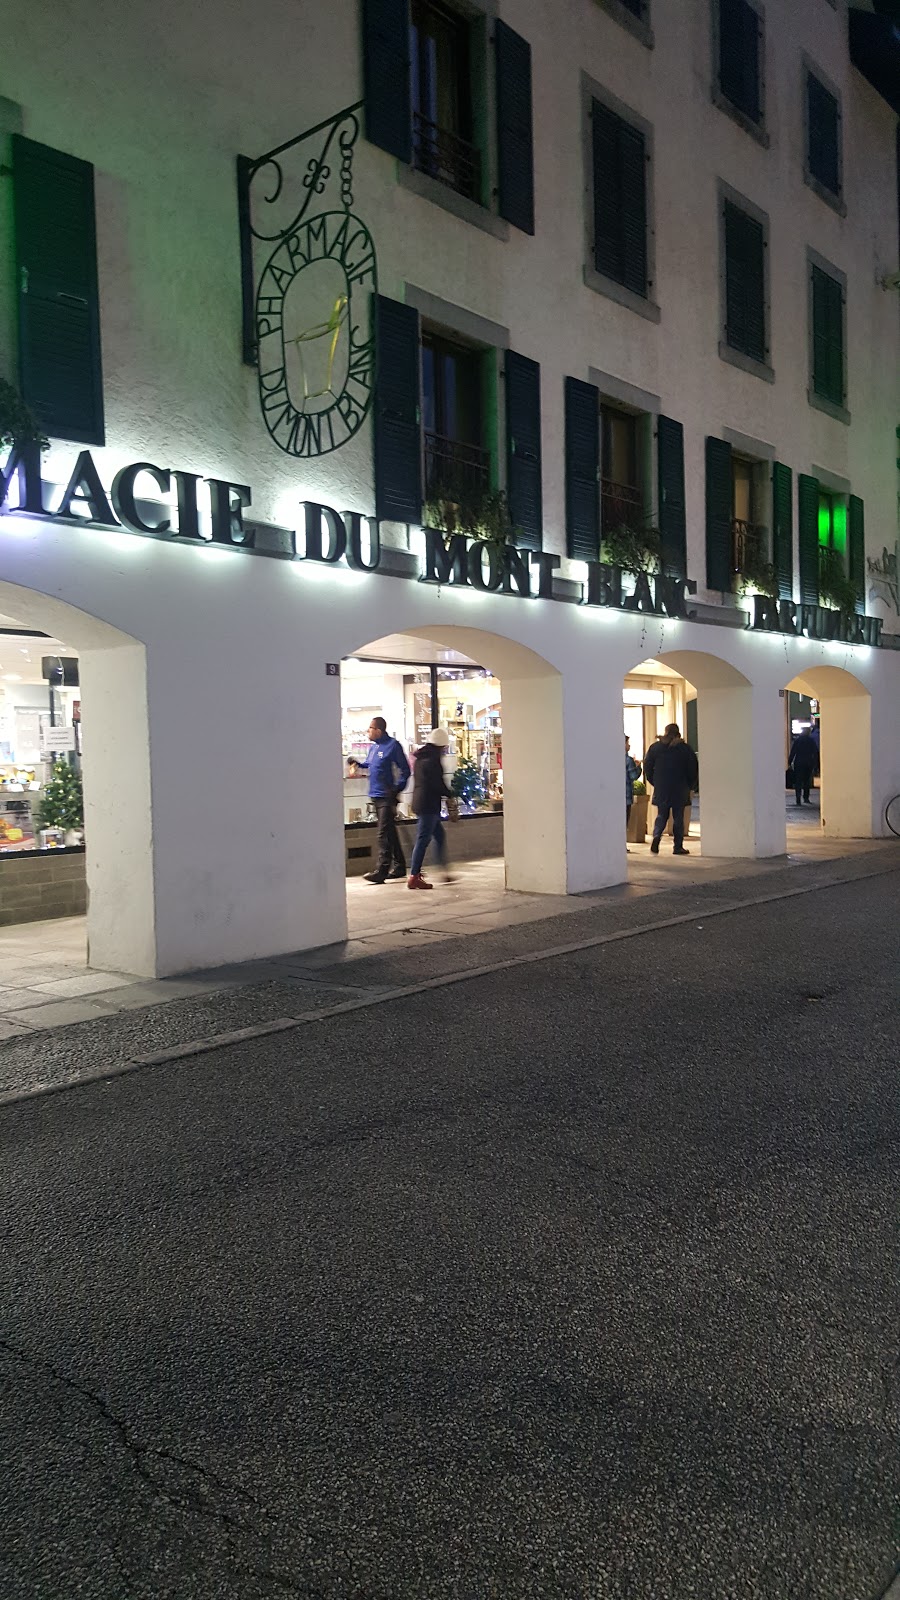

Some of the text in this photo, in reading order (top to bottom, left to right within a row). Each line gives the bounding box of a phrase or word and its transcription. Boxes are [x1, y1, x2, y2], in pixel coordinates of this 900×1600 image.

[257, 213, 376, 456] PHARMACIE DU MONT BLANC
[299, 501, 381, 571] DU
[419, 529, 561, 599] MONT
[587, 561, 697, 619] BLANC
